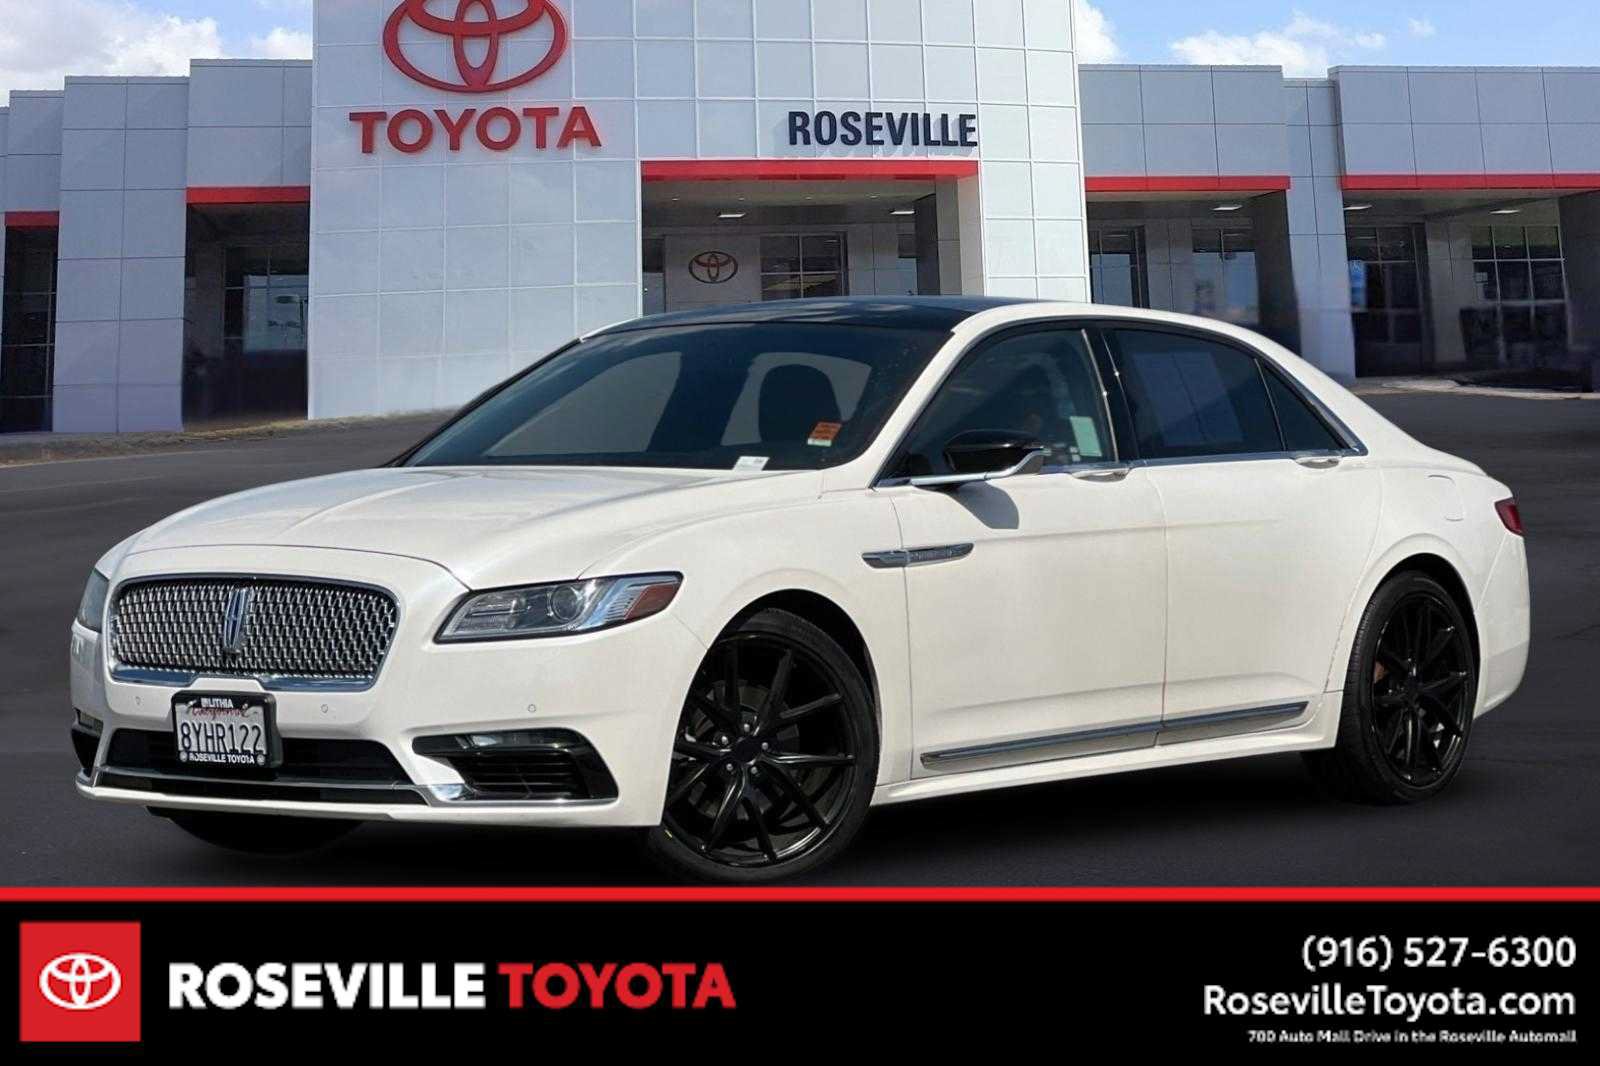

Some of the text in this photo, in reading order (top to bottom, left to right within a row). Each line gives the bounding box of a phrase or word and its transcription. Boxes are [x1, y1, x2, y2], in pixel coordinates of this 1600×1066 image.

[350, 106, 602, 154] TOYOTA
[788, 110, 978, 147] ROSEVILLE
[209, 697, 234, 708] LITHIA
[180, 721, 264, 755] 8YHR122
[188, 752, 255, 763] ROSEVILLE TOYOTA
